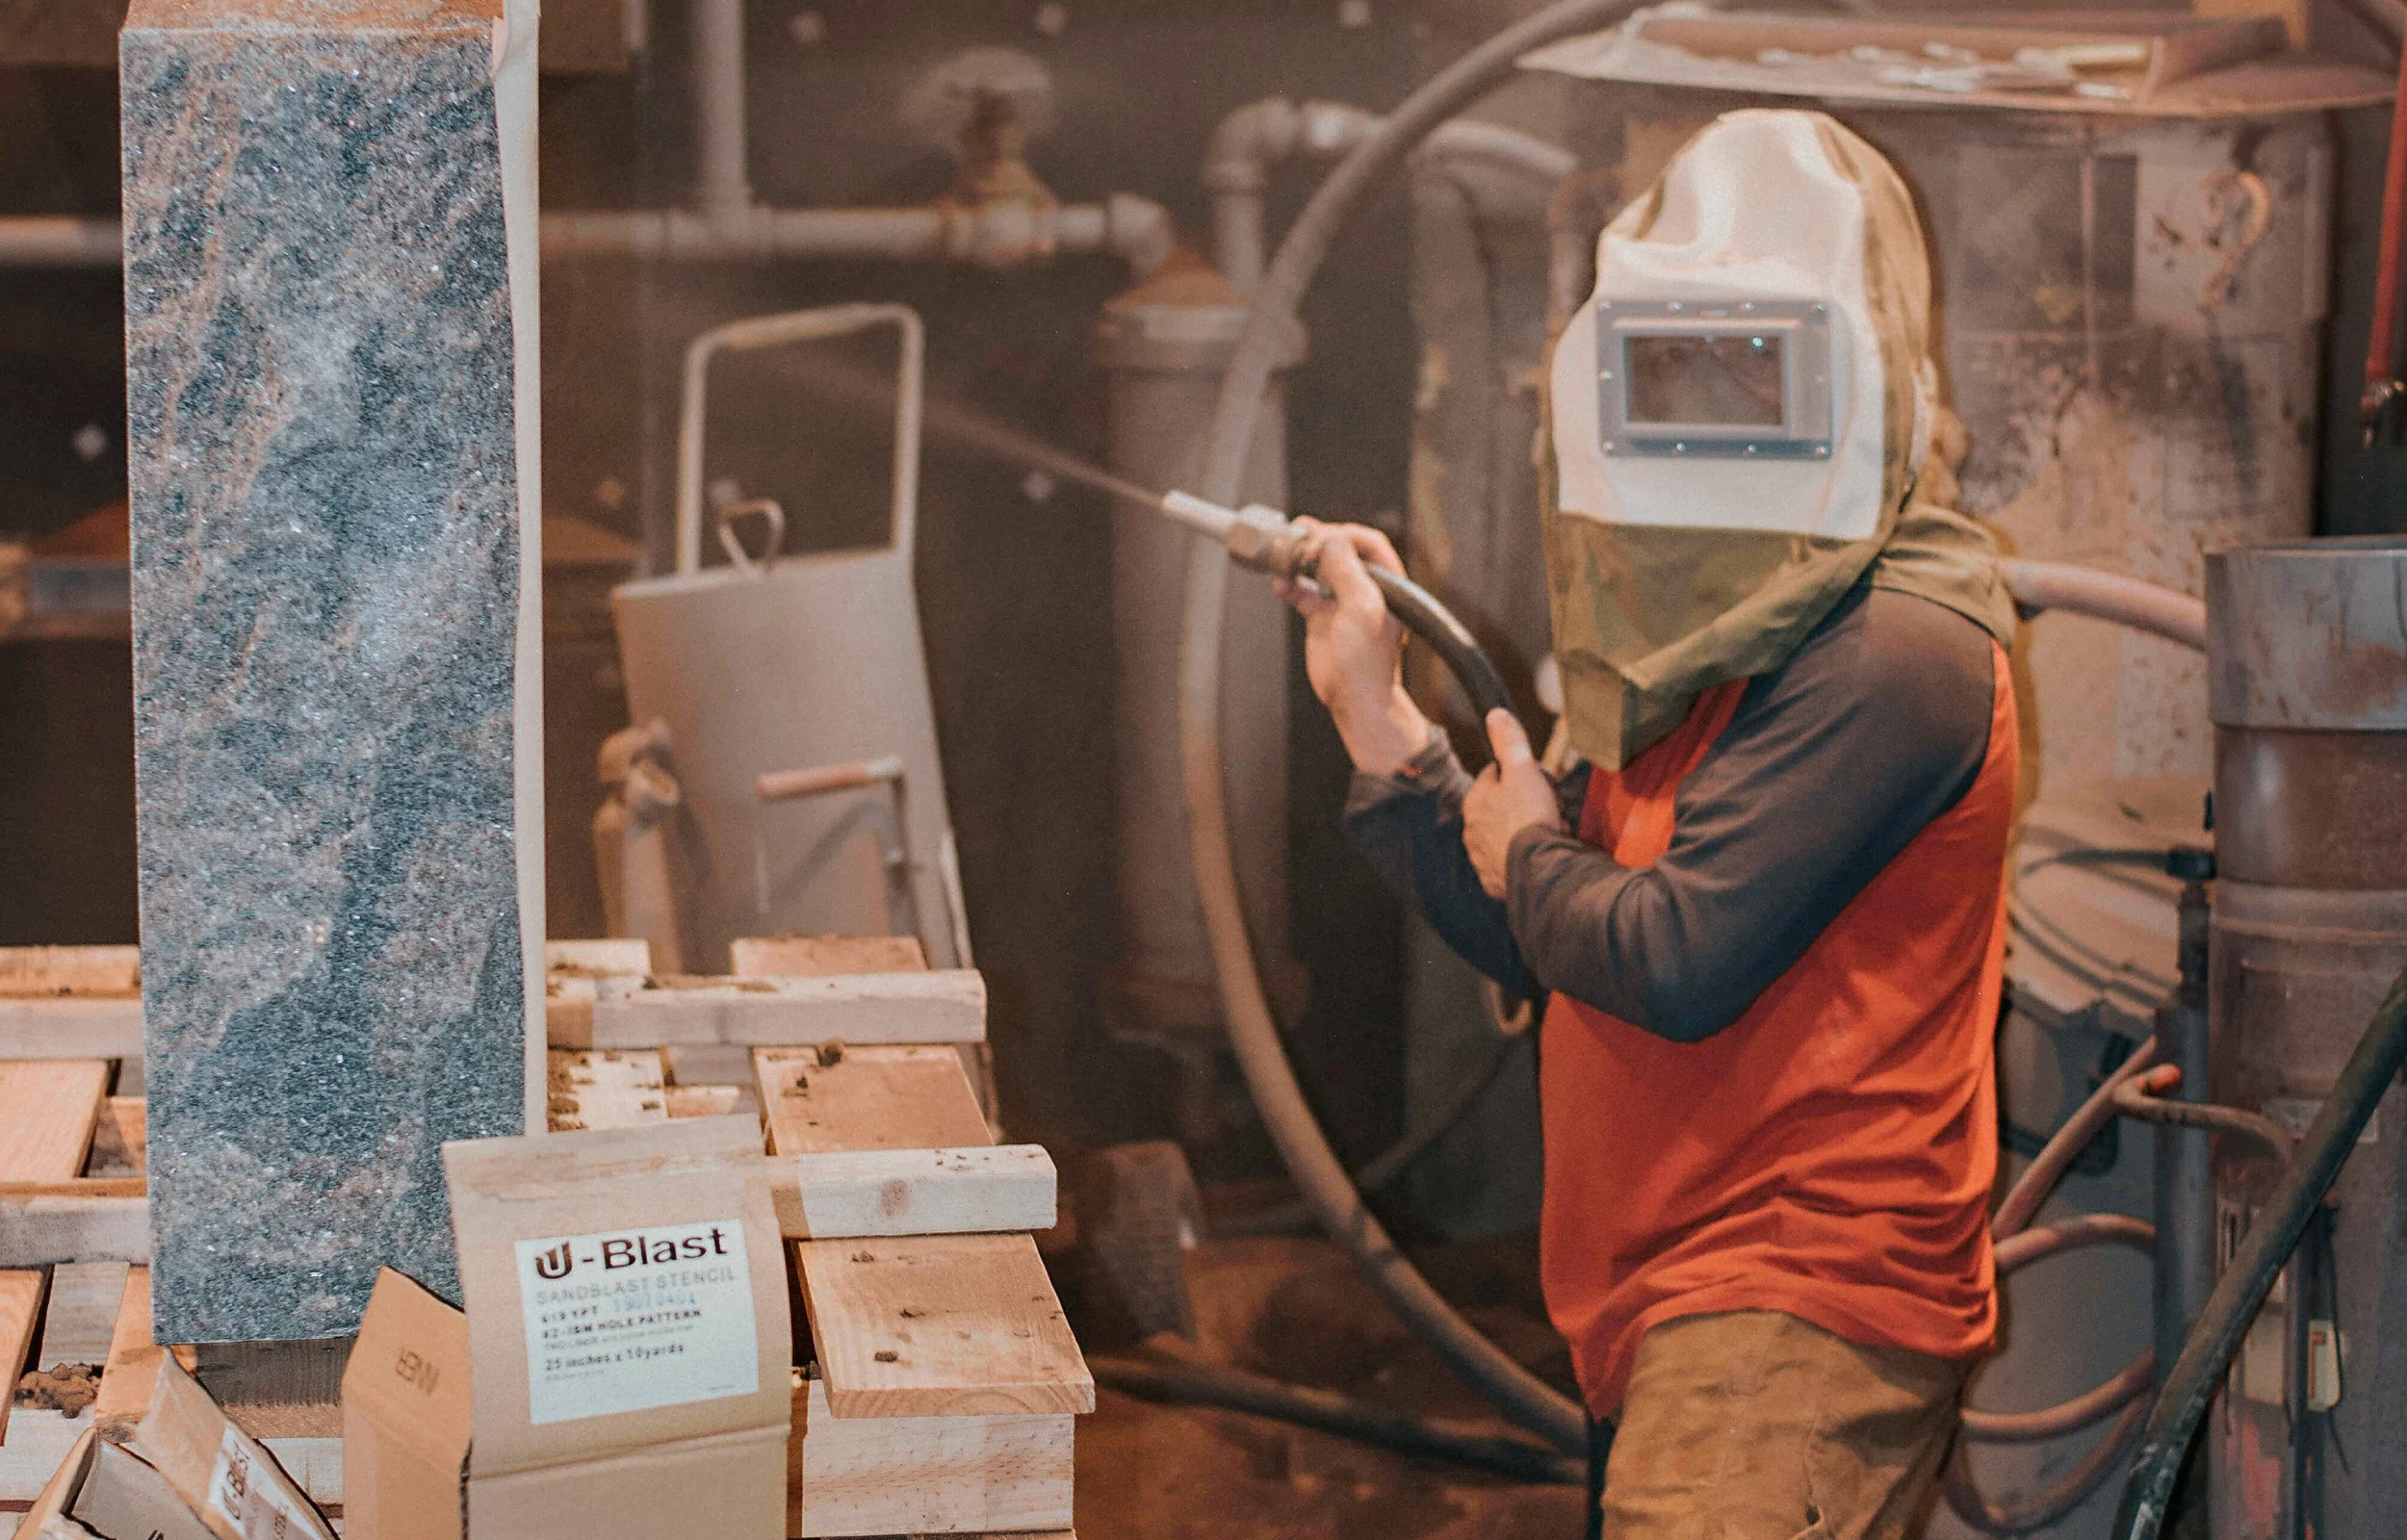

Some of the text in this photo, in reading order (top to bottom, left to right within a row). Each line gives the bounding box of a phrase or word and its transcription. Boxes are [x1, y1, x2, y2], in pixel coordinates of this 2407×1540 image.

[535, 1228, 728, 1280] U-Blast
[535, 1277, 650, 1305] SANDBLAST
[656, 1267, 737, 1289] STENCIL
[597, 1317, 634, 1330] HOLE
[638, 1309, 701, 1325] PATTERN
